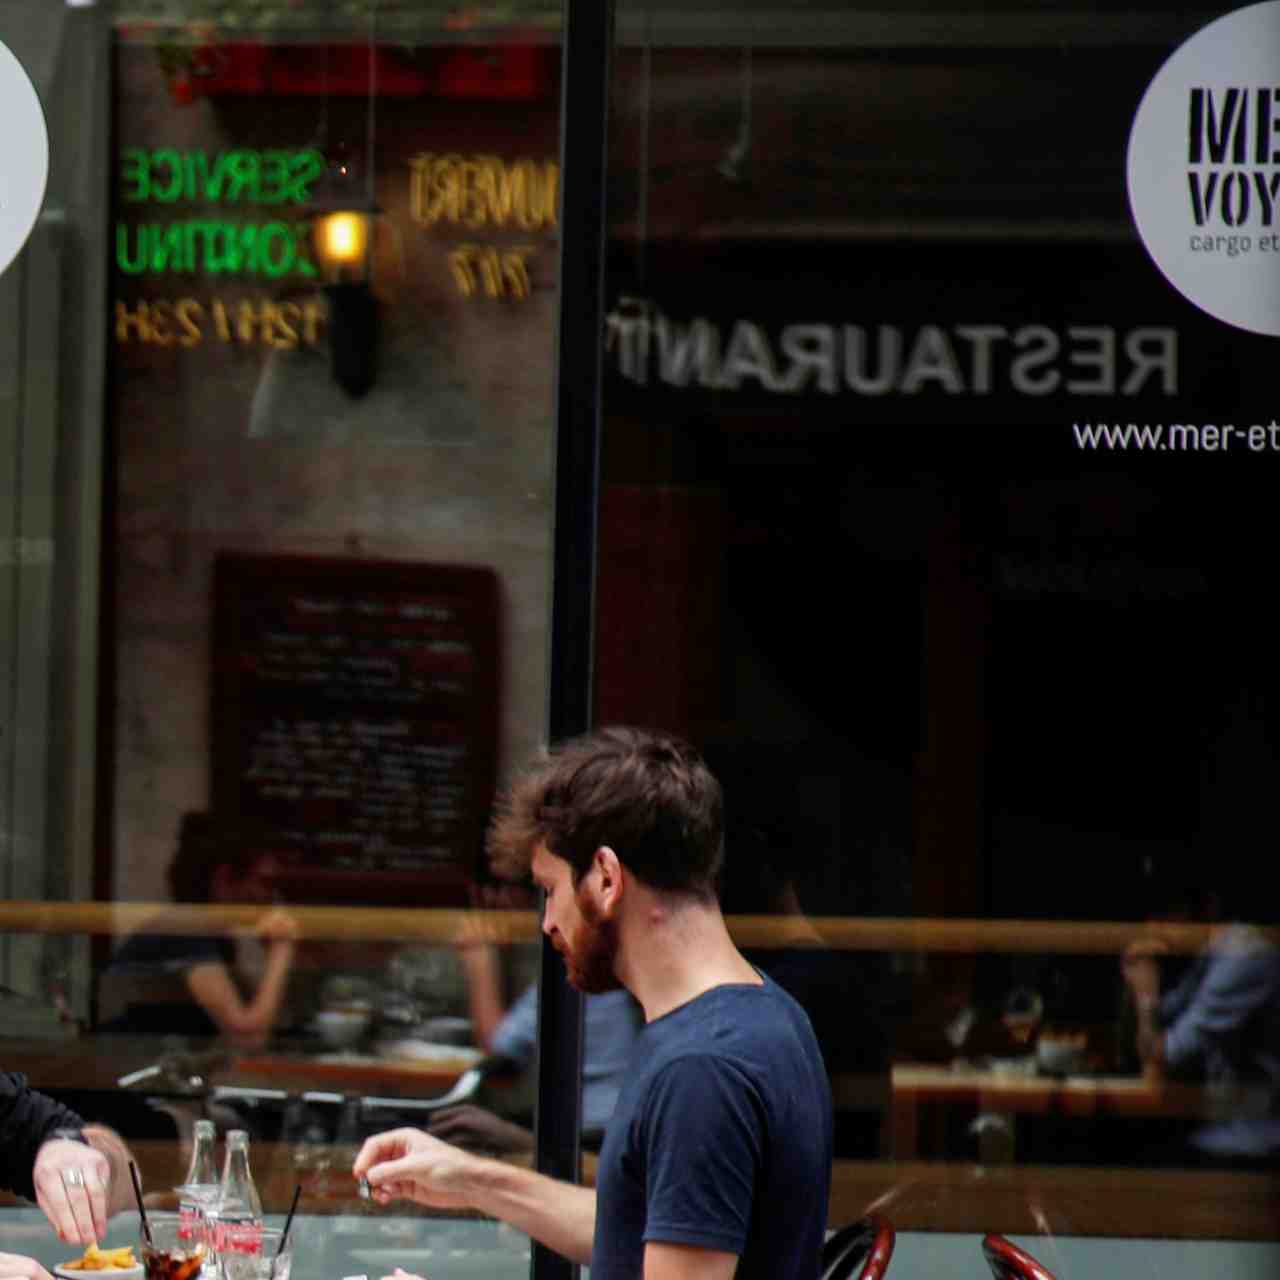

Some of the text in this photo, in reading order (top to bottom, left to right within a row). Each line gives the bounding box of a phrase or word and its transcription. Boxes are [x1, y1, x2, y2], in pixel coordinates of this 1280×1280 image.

[1187, 171, 1280, 227] VOY
[1189, 230, 1280, 257] cargo et
[1072, 420, 1280, 452] www.mer-et
